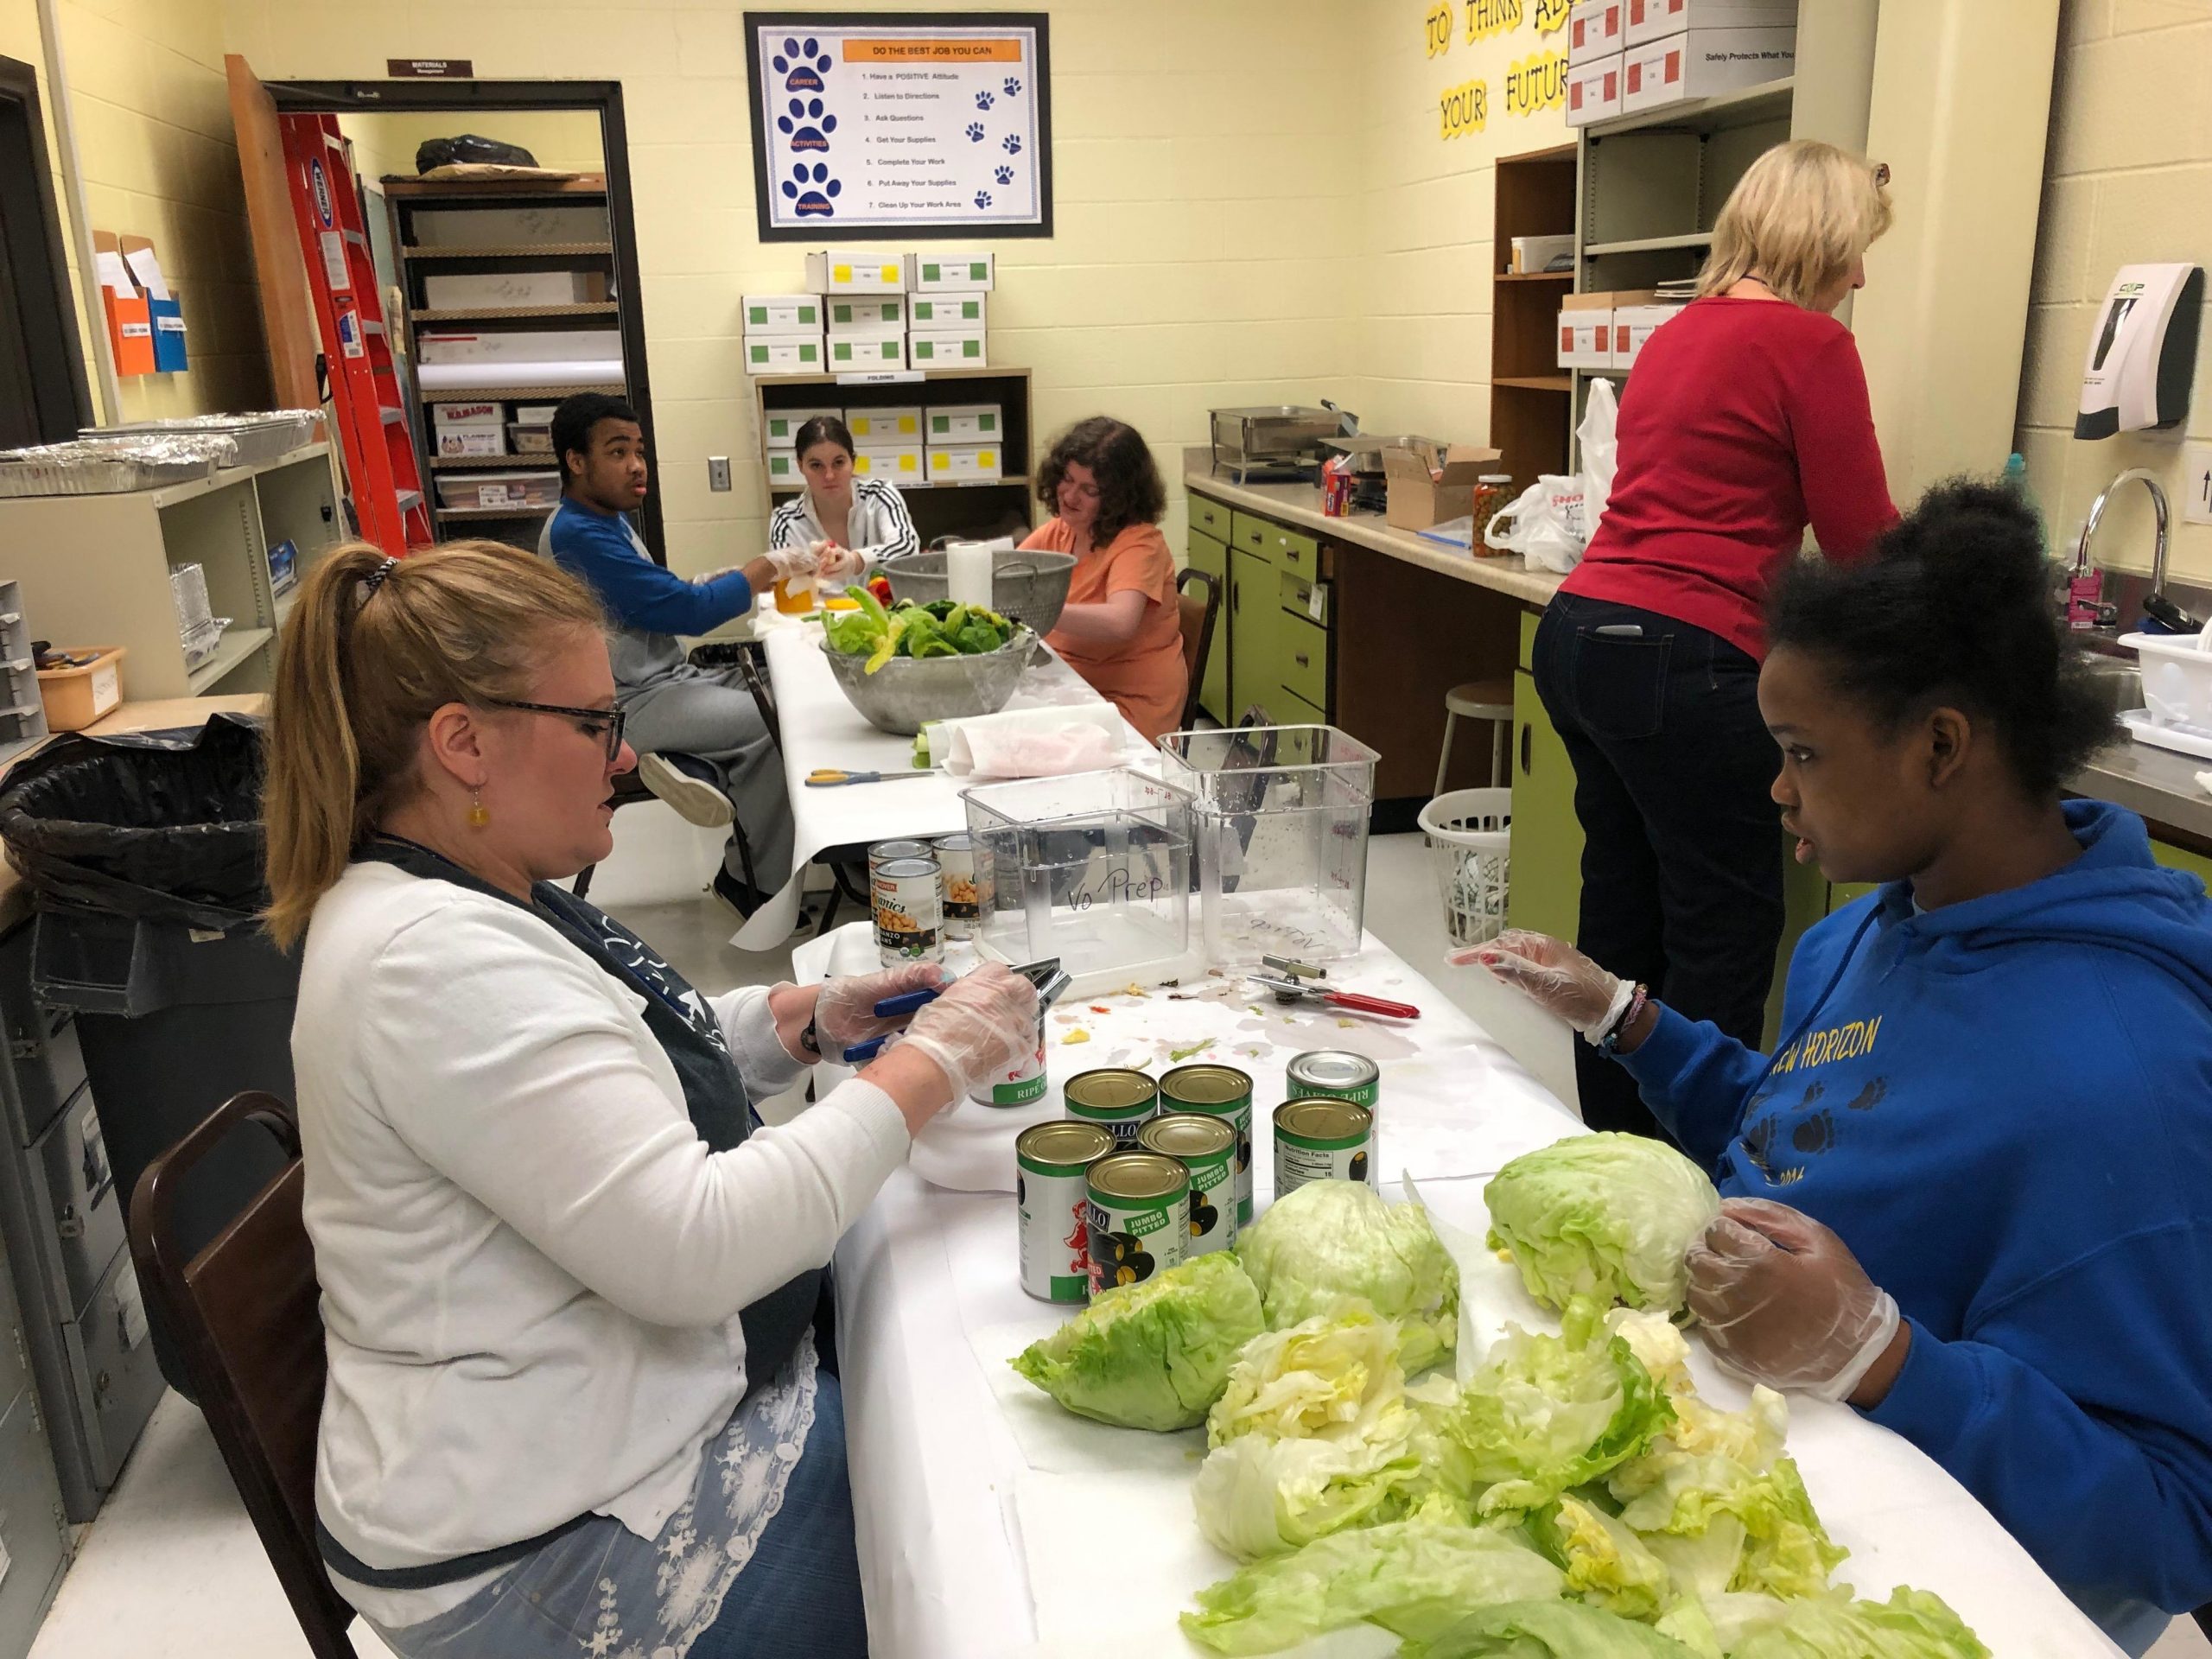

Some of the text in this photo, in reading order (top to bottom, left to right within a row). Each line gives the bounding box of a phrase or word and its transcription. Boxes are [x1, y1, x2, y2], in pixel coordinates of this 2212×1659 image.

[1427, 10, 1448, 50] TO
[873, 47, 992, 55] DO THE BEST JOB YOU CAN
[1705, 53, 1727, 61] Safely
[1729, 52, 1759, 60] Protects
[1761, 51, 1779, 60] What
[789, 78, 818, 86] CAREER
[1441, 58, 1569, 130] YOUR FUTUR
[927, 180, 957, 188] Supplies
[315, 171, 331, 219] WERNER
[1097, 868, 1163, 904] Prep
[878, 898, 906, 913] anics
[1801, 1015, 1883, 1070] HORIZON
[1017, 1084, 1040, 1099] RIPE
[1342, 1089, 1369, 1102] RIPE
[1112, 1123, 1136, 1137] LLO
[1285, 1144, 1310, 1157] Nutrition
[1197, 1165, 1224, 1181] JUMBO
[1198, 1171, 1227, 1191] PITTED
[1089, 1204, 1106, 1227] LLO
[1130, 1211, 1163, 1228] JUMBO
[1132, 1218, 1166, 1236] PITTED
